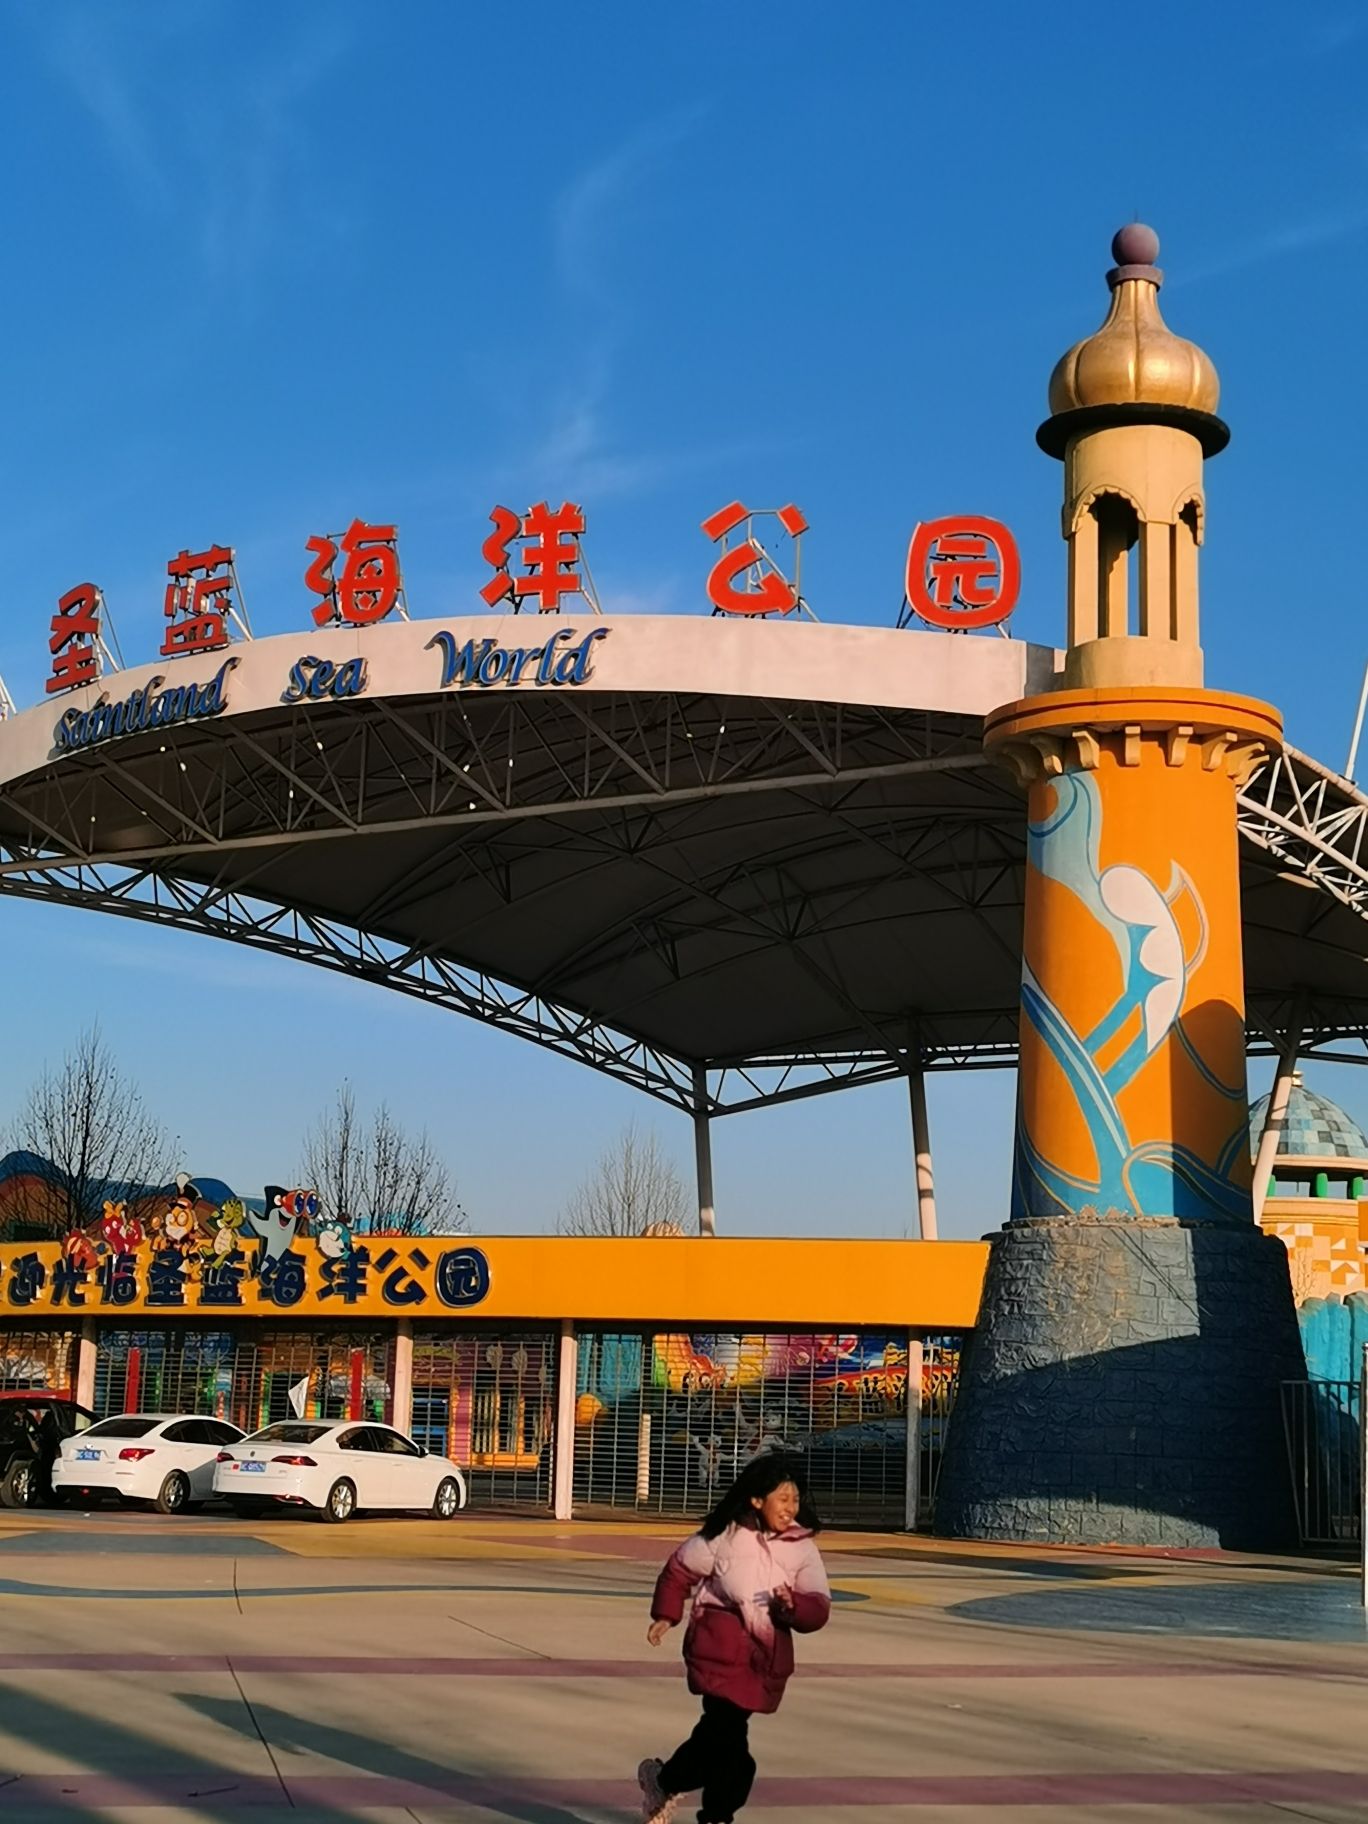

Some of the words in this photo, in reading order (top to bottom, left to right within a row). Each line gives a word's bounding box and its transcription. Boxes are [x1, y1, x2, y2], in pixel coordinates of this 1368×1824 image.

[46, 500, 1021, 693] 圣蓝海洋公园
[53, 657, 240, 753] Saintland
[283, 656, 367, 704] Sea
[427, 628, 609, 690] World
